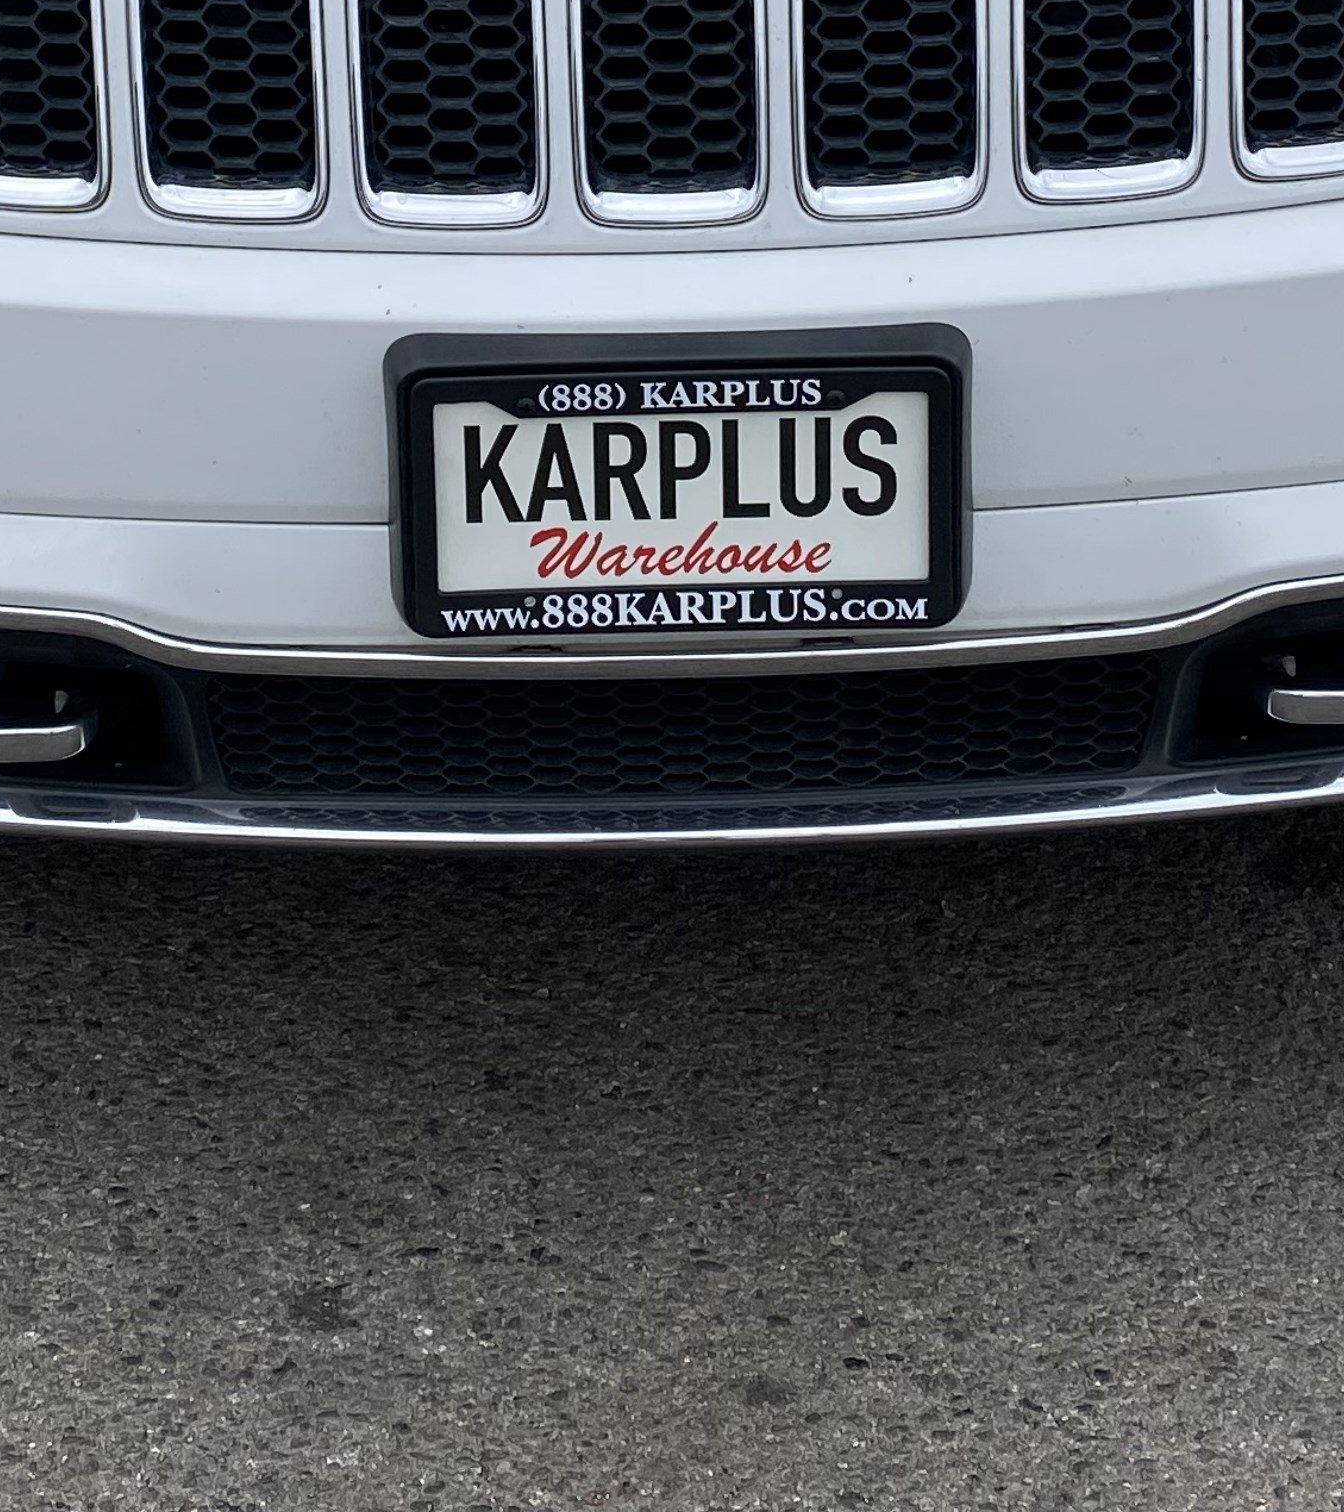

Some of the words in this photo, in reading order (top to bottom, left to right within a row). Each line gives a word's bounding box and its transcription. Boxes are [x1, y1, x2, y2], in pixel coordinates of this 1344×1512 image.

[537, 383, 627, 414] (888)
[640, 378, 823, 410] KARPLUS
[462, 414, 898, 524] KARPLUS
[529, 520, 832, 580] Warehouse
